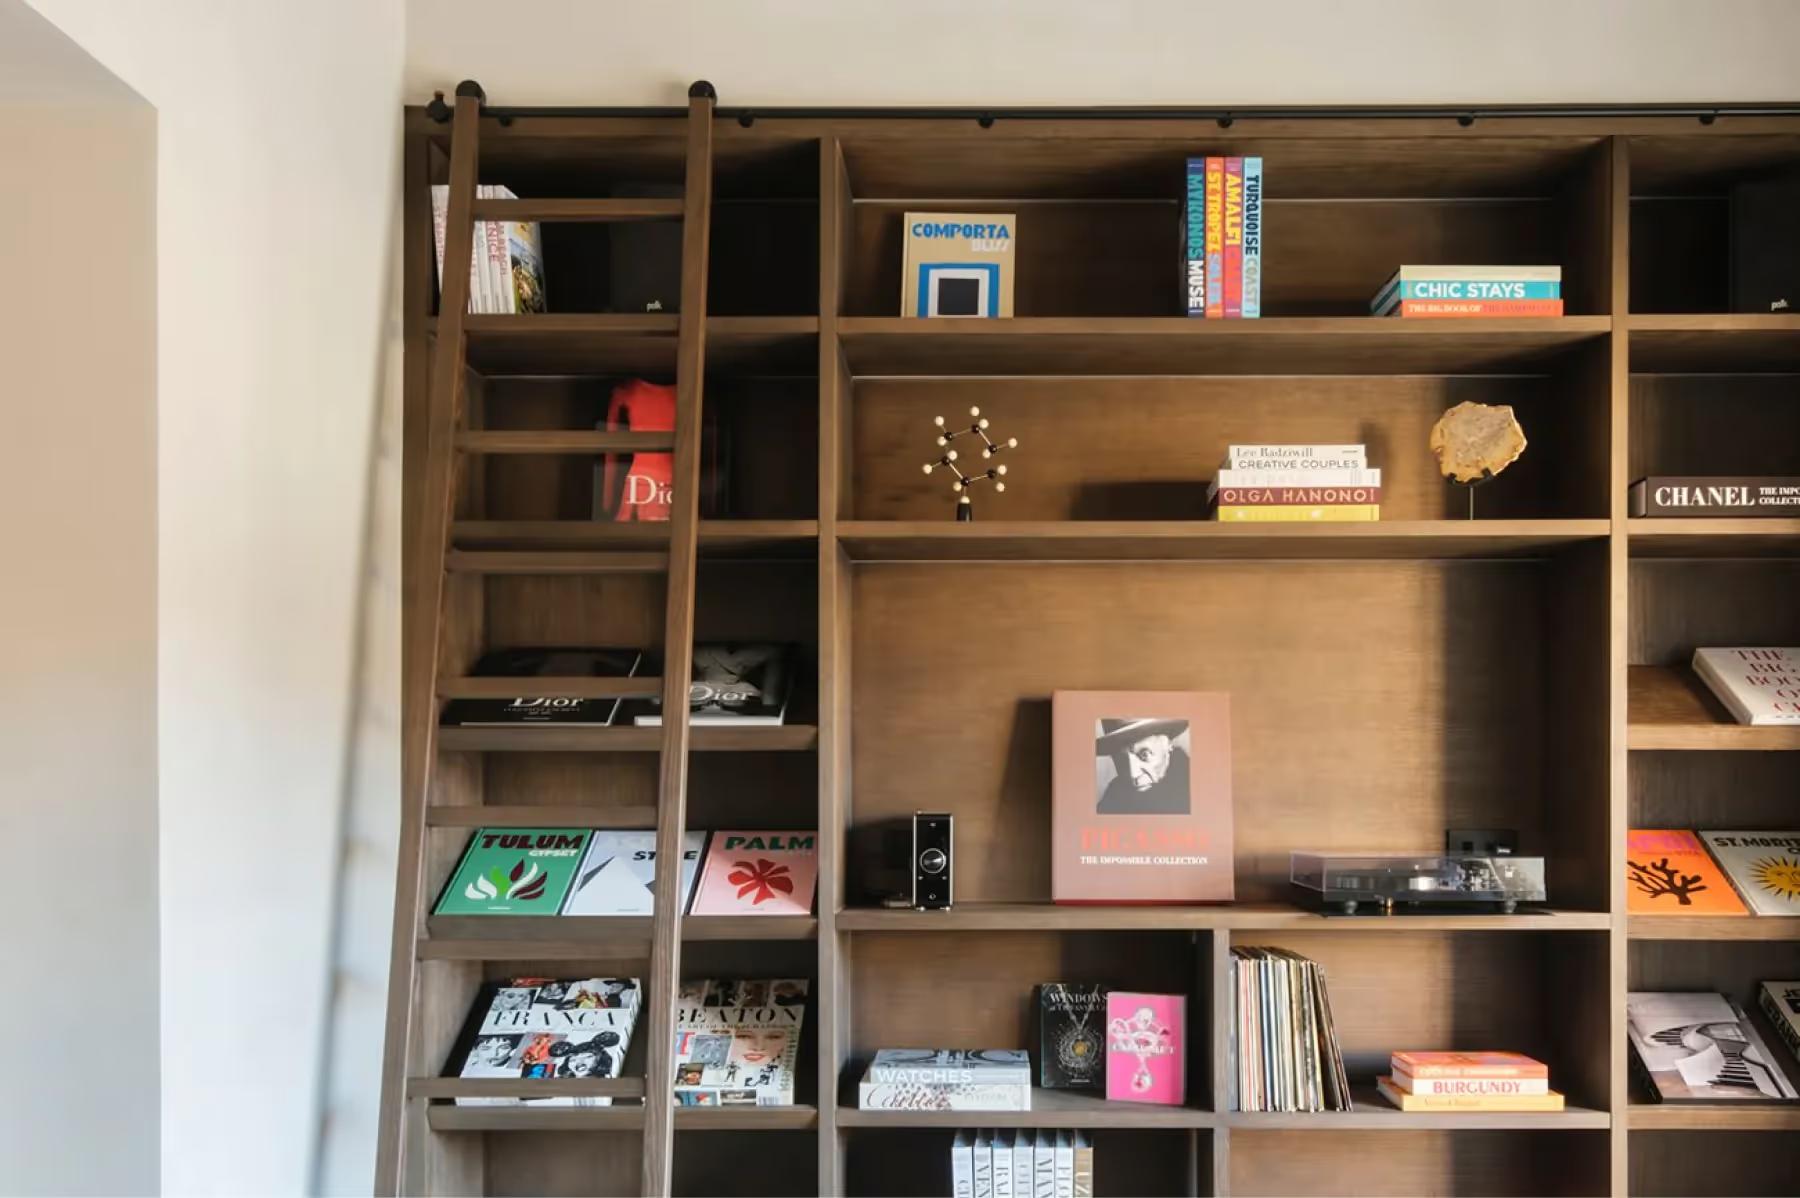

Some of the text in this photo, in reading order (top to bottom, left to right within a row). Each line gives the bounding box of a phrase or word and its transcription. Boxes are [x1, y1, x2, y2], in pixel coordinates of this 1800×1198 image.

[1225, 173, 1242, 245] AMALFI
[1206, 193, 1222, 252] TROPEZ
[912, 223, 1010, 239] COMPORTA
[1188, 174, 1204, 308] MYKONOS MUSE
[1245, 175, 1260, 305] TURQUOISE COAST
[1415, 282, 1526, 298] CHIC STAYS
[1237, 447, 1313, 457] Lee Radziwill
[1238, 459, 1359, 469] CREATIVE COUPLES
[624, 474, 673, 505] Di
[1223, 489, 1367, 503] OLGA HANONO
[1655, 486, 1755, 506] CHANEL
[1759, 486, 1778, 495] THE
[689, 685, 753, 701] Dior
[509, 697, 584, 707] Dior
[482, 834, 584, 849] TULUM
[724, 836, 815, 850] PALM
[633, 850, 699, 860] STE
[1080, 855, 1098, 865] THE
[1153, 855, 1208, 865] COLLECTION
[494, 1011, 615, 1026] FRANCA
[876, 1069, 974, 1084] WATCHES
[1433, 1081, 1521, 1094] BURGUNDY
